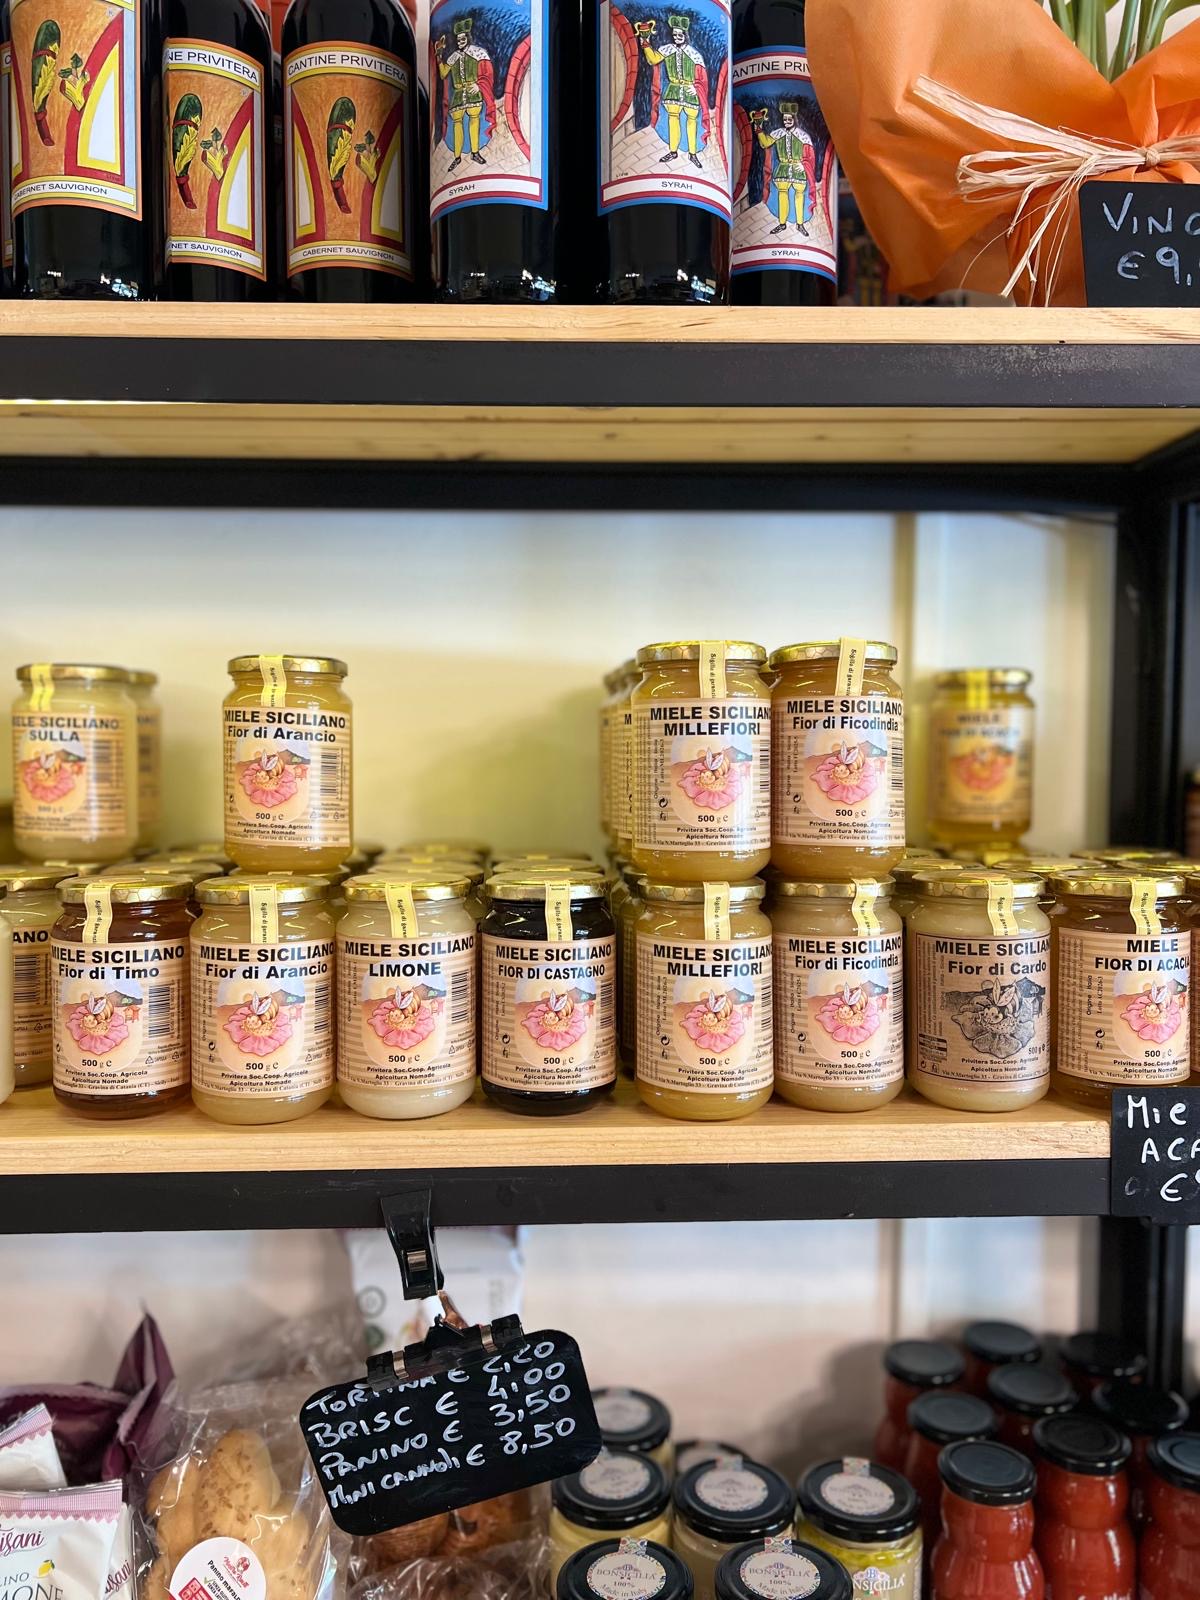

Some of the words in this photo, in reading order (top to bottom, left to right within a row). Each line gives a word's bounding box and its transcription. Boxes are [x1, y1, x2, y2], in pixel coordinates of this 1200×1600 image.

[187, 51, 258, 82] PRIVITERA
[288, 54, 336, 76] CANTINE
[341, 54, 407, 82] PRIVITERA
[732, 61, 779, 78] ANTINE
[48, 183, 107, 195] SAUVIGNON
[448, 183, 475, 197] SYRAH
[661, 181, 693, 190] SYRAH
[190, 243, 242, 259] SAUVIGNON
[302, 247, 343, 257] CABERNET
[345, 247, 395, 262] SAUVIGNON
[650, 706, 703, 720] MIELE
[709, 706, 771, 720] SICILIAN
[787, 699, 834, 713] MIELE
[840, 699, 902, 715] SICILIANO
[40, 716, 120, 730] SICILIANO
[224, 710, 260, 723] MIELE
[265, 711, 346, 728] SICILIANO
[792, 716, 819, 730] Fior
[822, 716, 835, 729] di
[840, 716, 898, 731] Ficodindia
[29, 729, 80, 742] SULLA
[228, 725, 249, 738] Fior
[253, 726, 268, 738] di
[273, 727, 336, 742] Arancio
[664, 722, 760, 736] MILLEFIORI
[255, 812, 271, 820] 500
[12, 930, 49, 944] ANO
[200, 945, 250, 962] MIELE
[256, 940, 335, 962] SICILIANO
[345, 941, 391, 957] MIELE
[398, 935, 474, 957] SICILIANO
[495, 945, 539, 962] MIELE
[544, 943, 611, 962] SICILIANO
[653, 944, 706, 961] MIELE
[788, 939, 836, 954] MIELE
[841, 936, 901, 955] SICILIANO
[935, 939, 990, 956] MIELE
[996, 937, 1050, 956] SICILIAN
[1126, 938, 1179, 953] MIELE
[51, 945, 86, 963] MIELE
[91, 945, 185, 963] SICILIANO
[795, 955, 820, 970] Fior
[825, 956, 838, 970] di
[842, 954, 899, 970] Ficodindia
[58, 963, 84, 979] Fior
[89, 965, 105, 979] di
[112, 965, 160, 979] Timo
[205, 963, 236, 979] Fior
[242, 963, 259, 979] di
[266, 961, 327, 979] Arancio
[369, 962, 441, 977] LIMONE
[498, 966, 523, 979] FIOR
[528, 967, 540, 979] DI
[544, 964, 605, 980] CASTAGNO
[667, 961, 762, 977] MILLEFIORI
[947, 960, 982, 975] Fior
[988, 960, 1004, 975] di
[1010, 959, 1047, 975] Cardo
[1095, 957, 1132, 972] FIOR
[1137, 959, 1152, 972] DI
[840, 1050, 858, 1058] 500
[1028, 1046, 1038, 1055] 500
[81, 1059, 98, 1067] 500
[245, 1062, 264, 1070] 500
[427, 1062, 451, 1071] Agricola
[699, 1057, 716, 1065] 500
[814, 1061, 842, 1069] Privitera
[1113, 1059, 1141, 1067] Privitera
[283, 1069, 308, 1078] Agricola
[1141, 1137, 1200, 1164] ACA
[435, 1391, 458, 1416] €
[487, 1361, 566, 1399] 4,00
[319, 1432, 428, 1481] PANINO
[442, 1420, 464, 1442] €
[488, 1384, 571, 1427] 3,50
[465, 1443, 486, 1466] €
[499, 1417, 576, 1455] 8,50
[207, 1559, 224, 1582] Panino
[853, 1578, 905, 1591] NSICILIA
